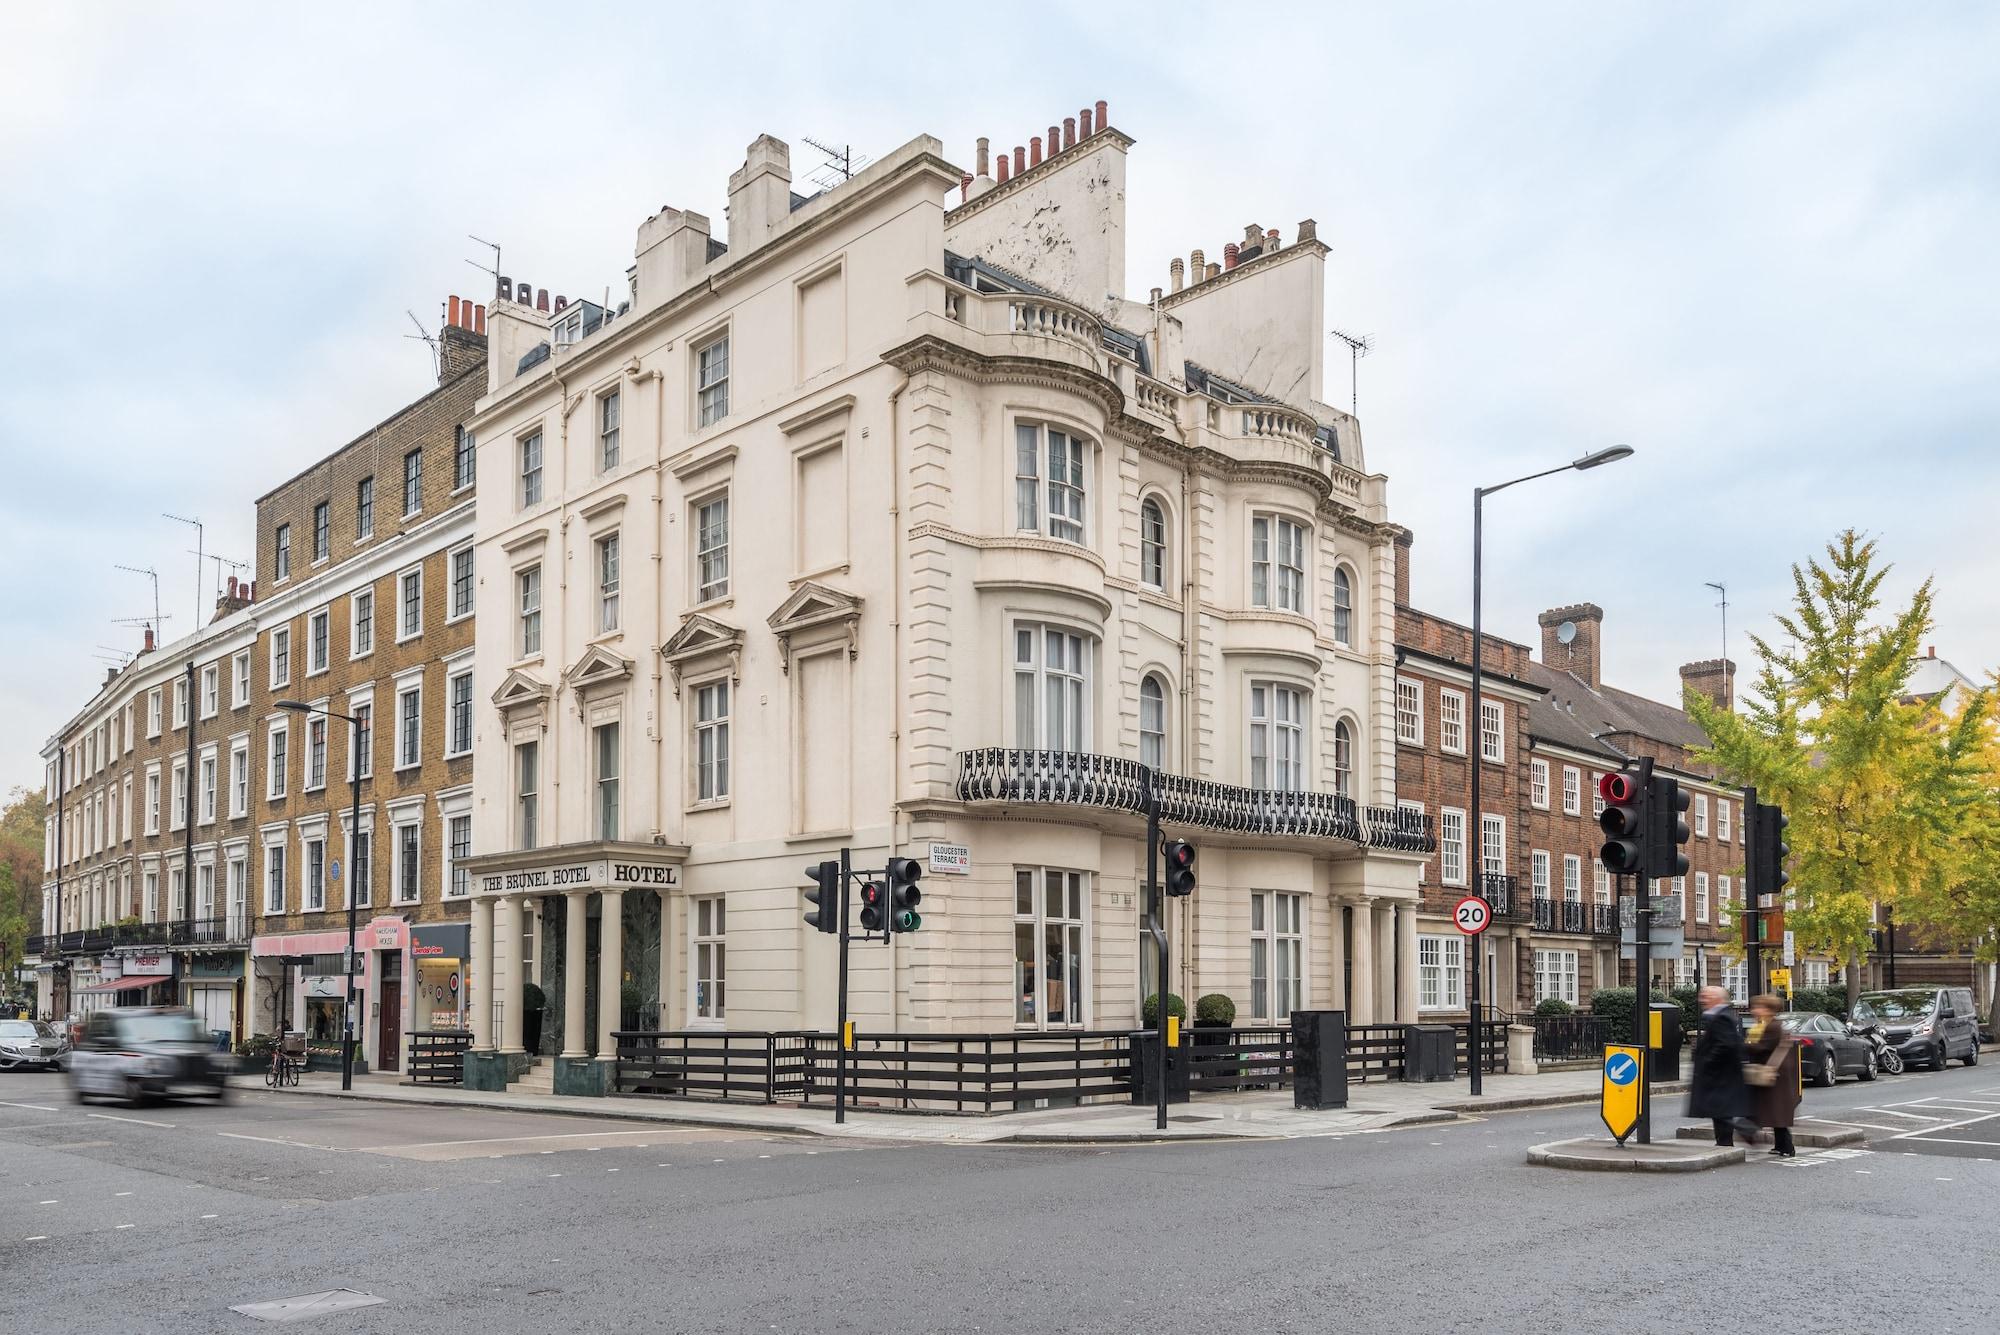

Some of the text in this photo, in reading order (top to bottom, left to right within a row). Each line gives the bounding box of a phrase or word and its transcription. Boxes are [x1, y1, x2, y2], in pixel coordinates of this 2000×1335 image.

[933, 846, 968, 856] GLOUCESTER
[934, 855, 957, 864] TERRACE
[483, 866, 590, 891] THE BRUNEL HOTEL
[614, 864, 677, 884] HOTEL
[1459, 908, 1484, 923] 20
[135, 956, 160, 966] PREMIER
